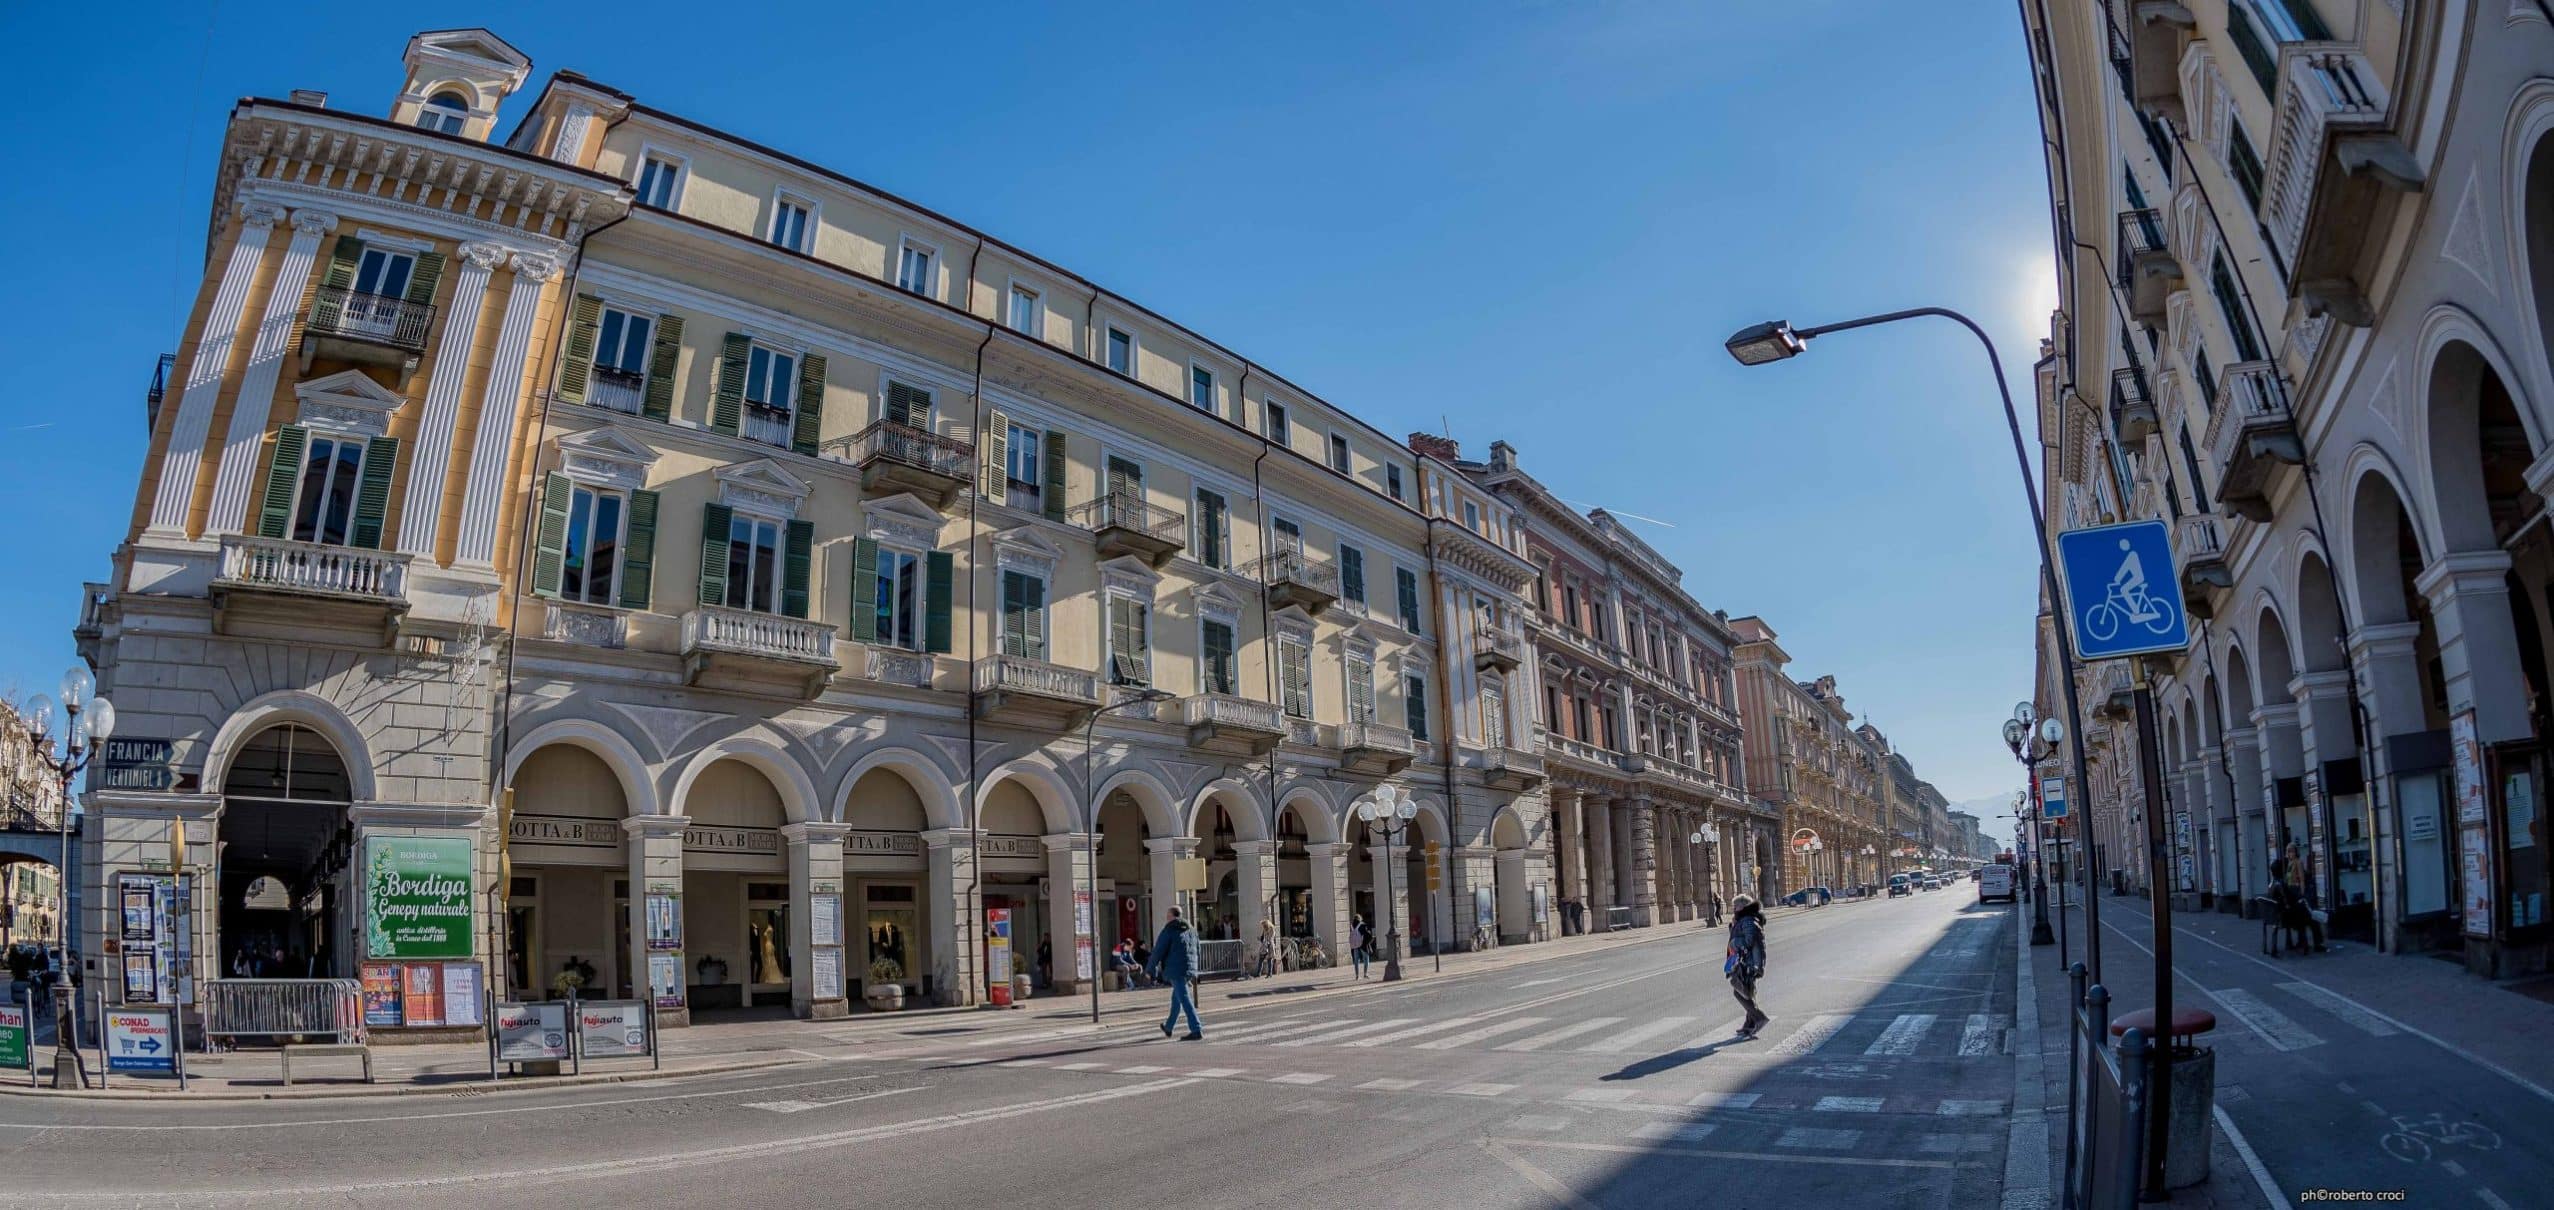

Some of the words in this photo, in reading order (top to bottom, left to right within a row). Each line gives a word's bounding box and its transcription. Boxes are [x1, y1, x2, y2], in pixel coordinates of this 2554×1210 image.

[108, 741, 163, 761] FRANCIA
[2034, 759, 2060, 769] UNEO
[106, 768, 162, 787] VENTIMIGLA
[573, 825, 583, 838] B
[683, 831, 725, 846] OTTA
[736, 834, 745, 847] B
[884, 837, 891, 849] B
[380, 872, 468, 904] Bordiga
[379, 898, 419, 921] Genepy
[421, 899, 470, 916] naturale
[0, 1010, 22, 1026] han
[119, 1018, 150, 1027] CONAD
[500, 1017, 540, 1028] fujiauto
[583, 1015, 623, 1026] fujiauto
